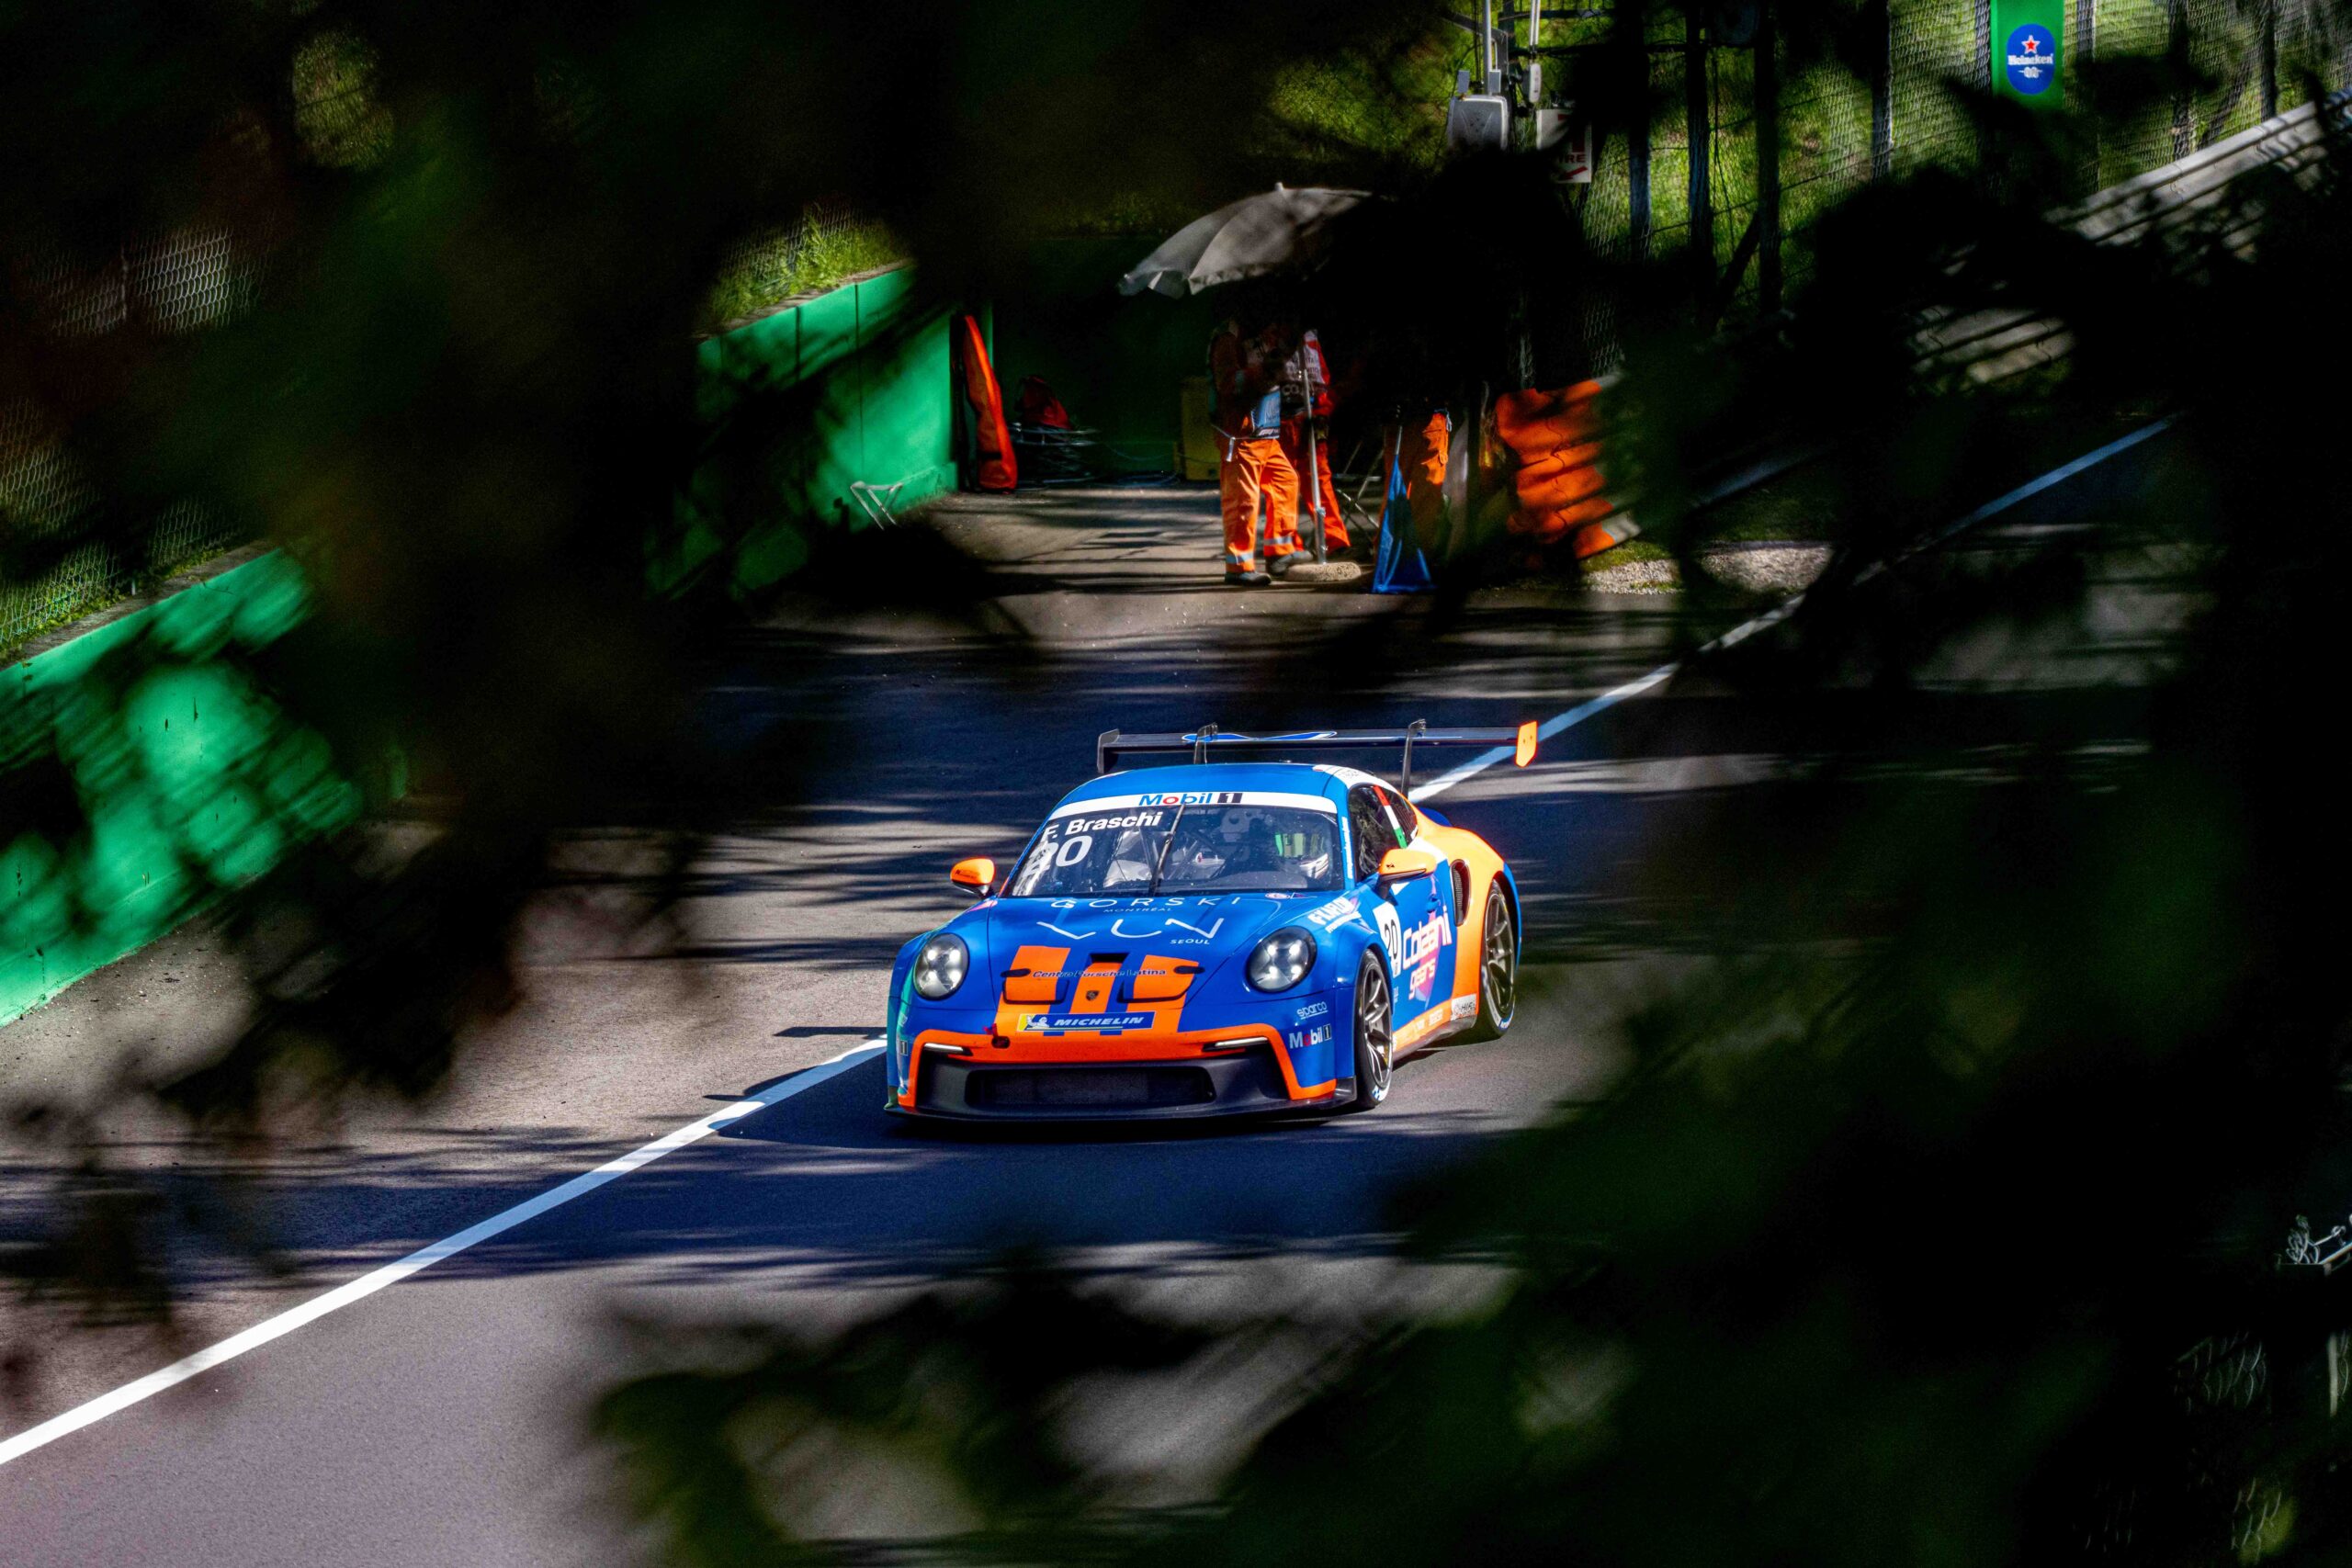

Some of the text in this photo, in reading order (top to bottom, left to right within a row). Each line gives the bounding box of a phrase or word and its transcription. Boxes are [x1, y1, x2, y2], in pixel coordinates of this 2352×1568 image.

[2007, 54, 2053, 65] Heineken
[1138, 793, 1213, 807] Mobil
[1064, 812, 1164, 836] Braschi
[1050, 897, 1240, 908] GORSKI
[1296, 1000, 1328, 1017] sparco
[1054, 1016, 1145, 1027] MICHELIN
[1289, 1028, 1324, 1049] Mobil
